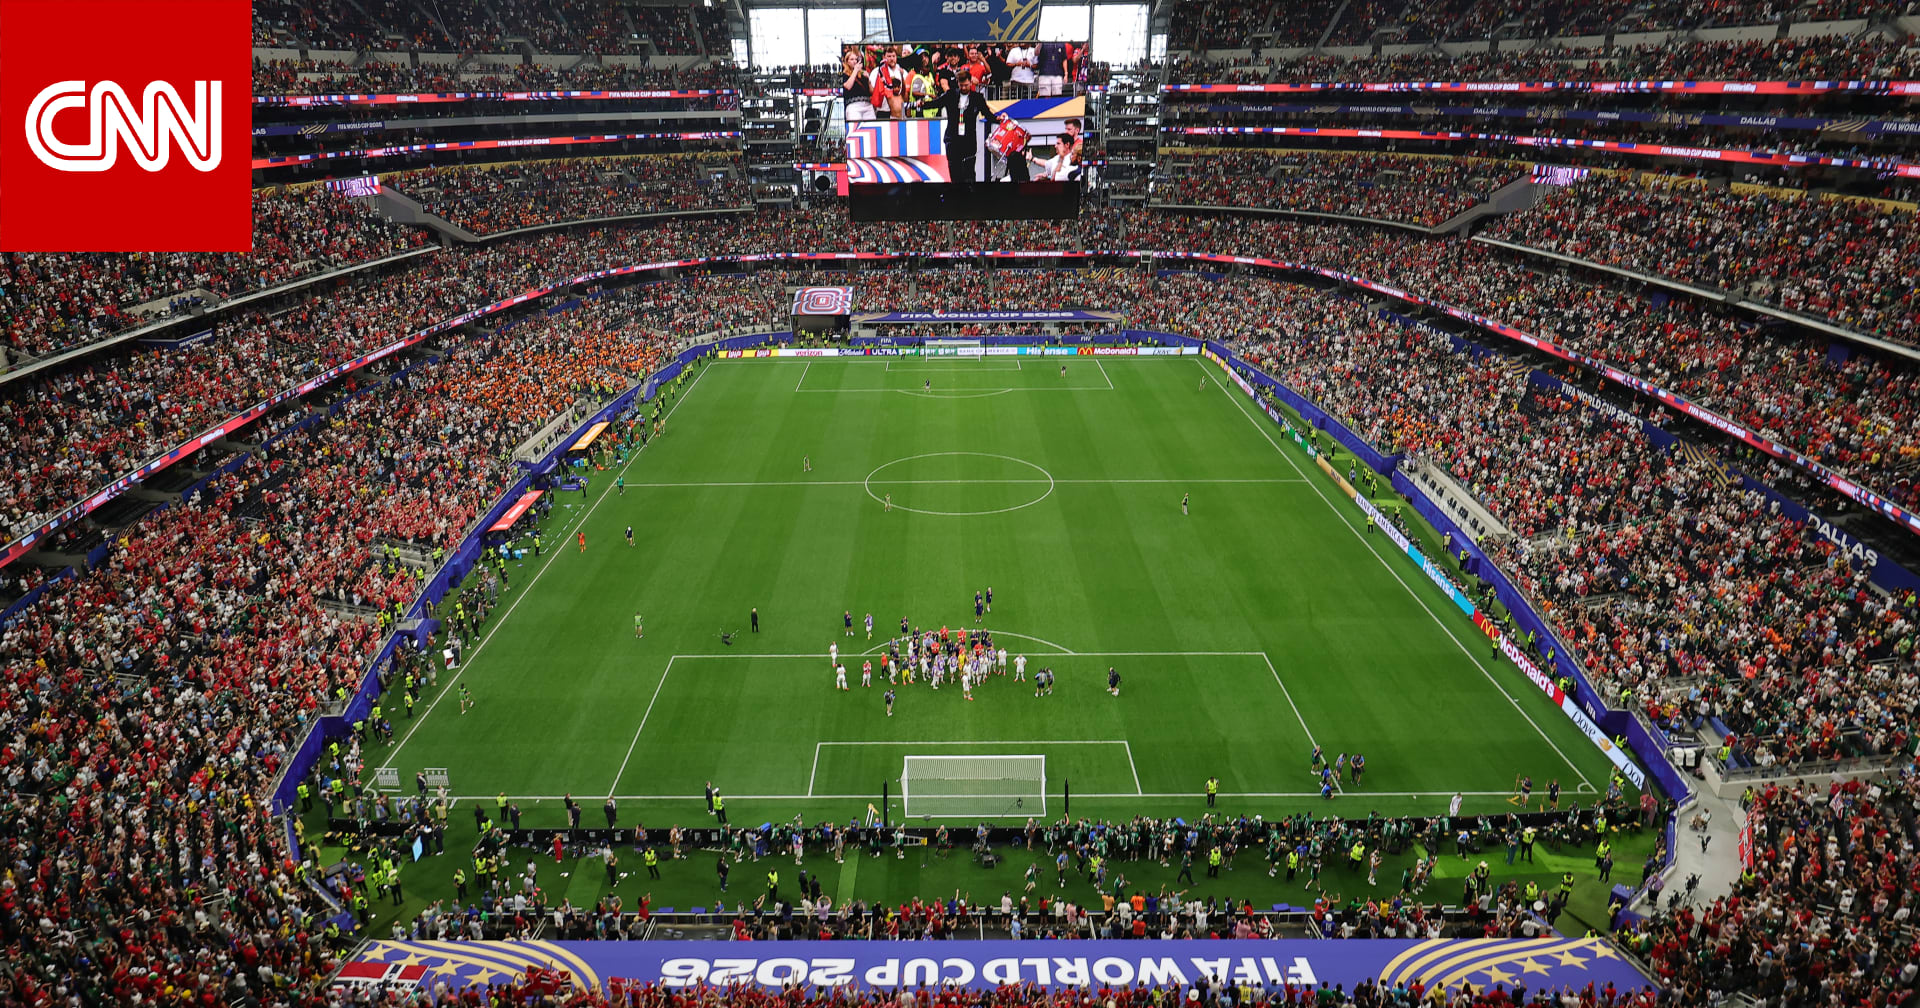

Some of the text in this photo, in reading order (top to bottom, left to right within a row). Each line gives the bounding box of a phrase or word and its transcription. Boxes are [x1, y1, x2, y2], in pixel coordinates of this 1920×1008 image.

[942, 1, 990, 13] 2026
[1740, 116, 1776, 126] DALLAS
[1882, 122, 1898, 131] FIFA
[1660, 146, 1672, 155] FIFA
[1672, 147, 1691, 156] WORLD
[1691, 149, 1702, 157] CUP
[795, 349, 823, 357] verizon
[871, 348, 898, 356] ULTRA
[1026, 347, 1069, 356] Hiense
[1093, 347, 1137, 356] McDonald's
[1561, 382, 1576, 397] FIFA
[1576, 389, 1601, 410] WORLD
[1600, 402, 1617, 417] CUP
[1688, 405, 1699, 417] FIFA
[1699, 410, 1717, 425] WORLD
[1716, 418, 1728, 430] CUP
[1357, 494, 1371, 511] BANK
[1377, 515, 1401, 545] AMERICA
[1807, 512, 1878, 567] DALLAS
[1422, 559, 1455, 600] Hisense
[1499, 633, 1555, 698] McDonald's
[1585, 700, 1596, 721] FIFA
[1571, 709, 1596, 739] Dove
[659, 957, 1318, 987] FIFA WORLD CUP 2026
